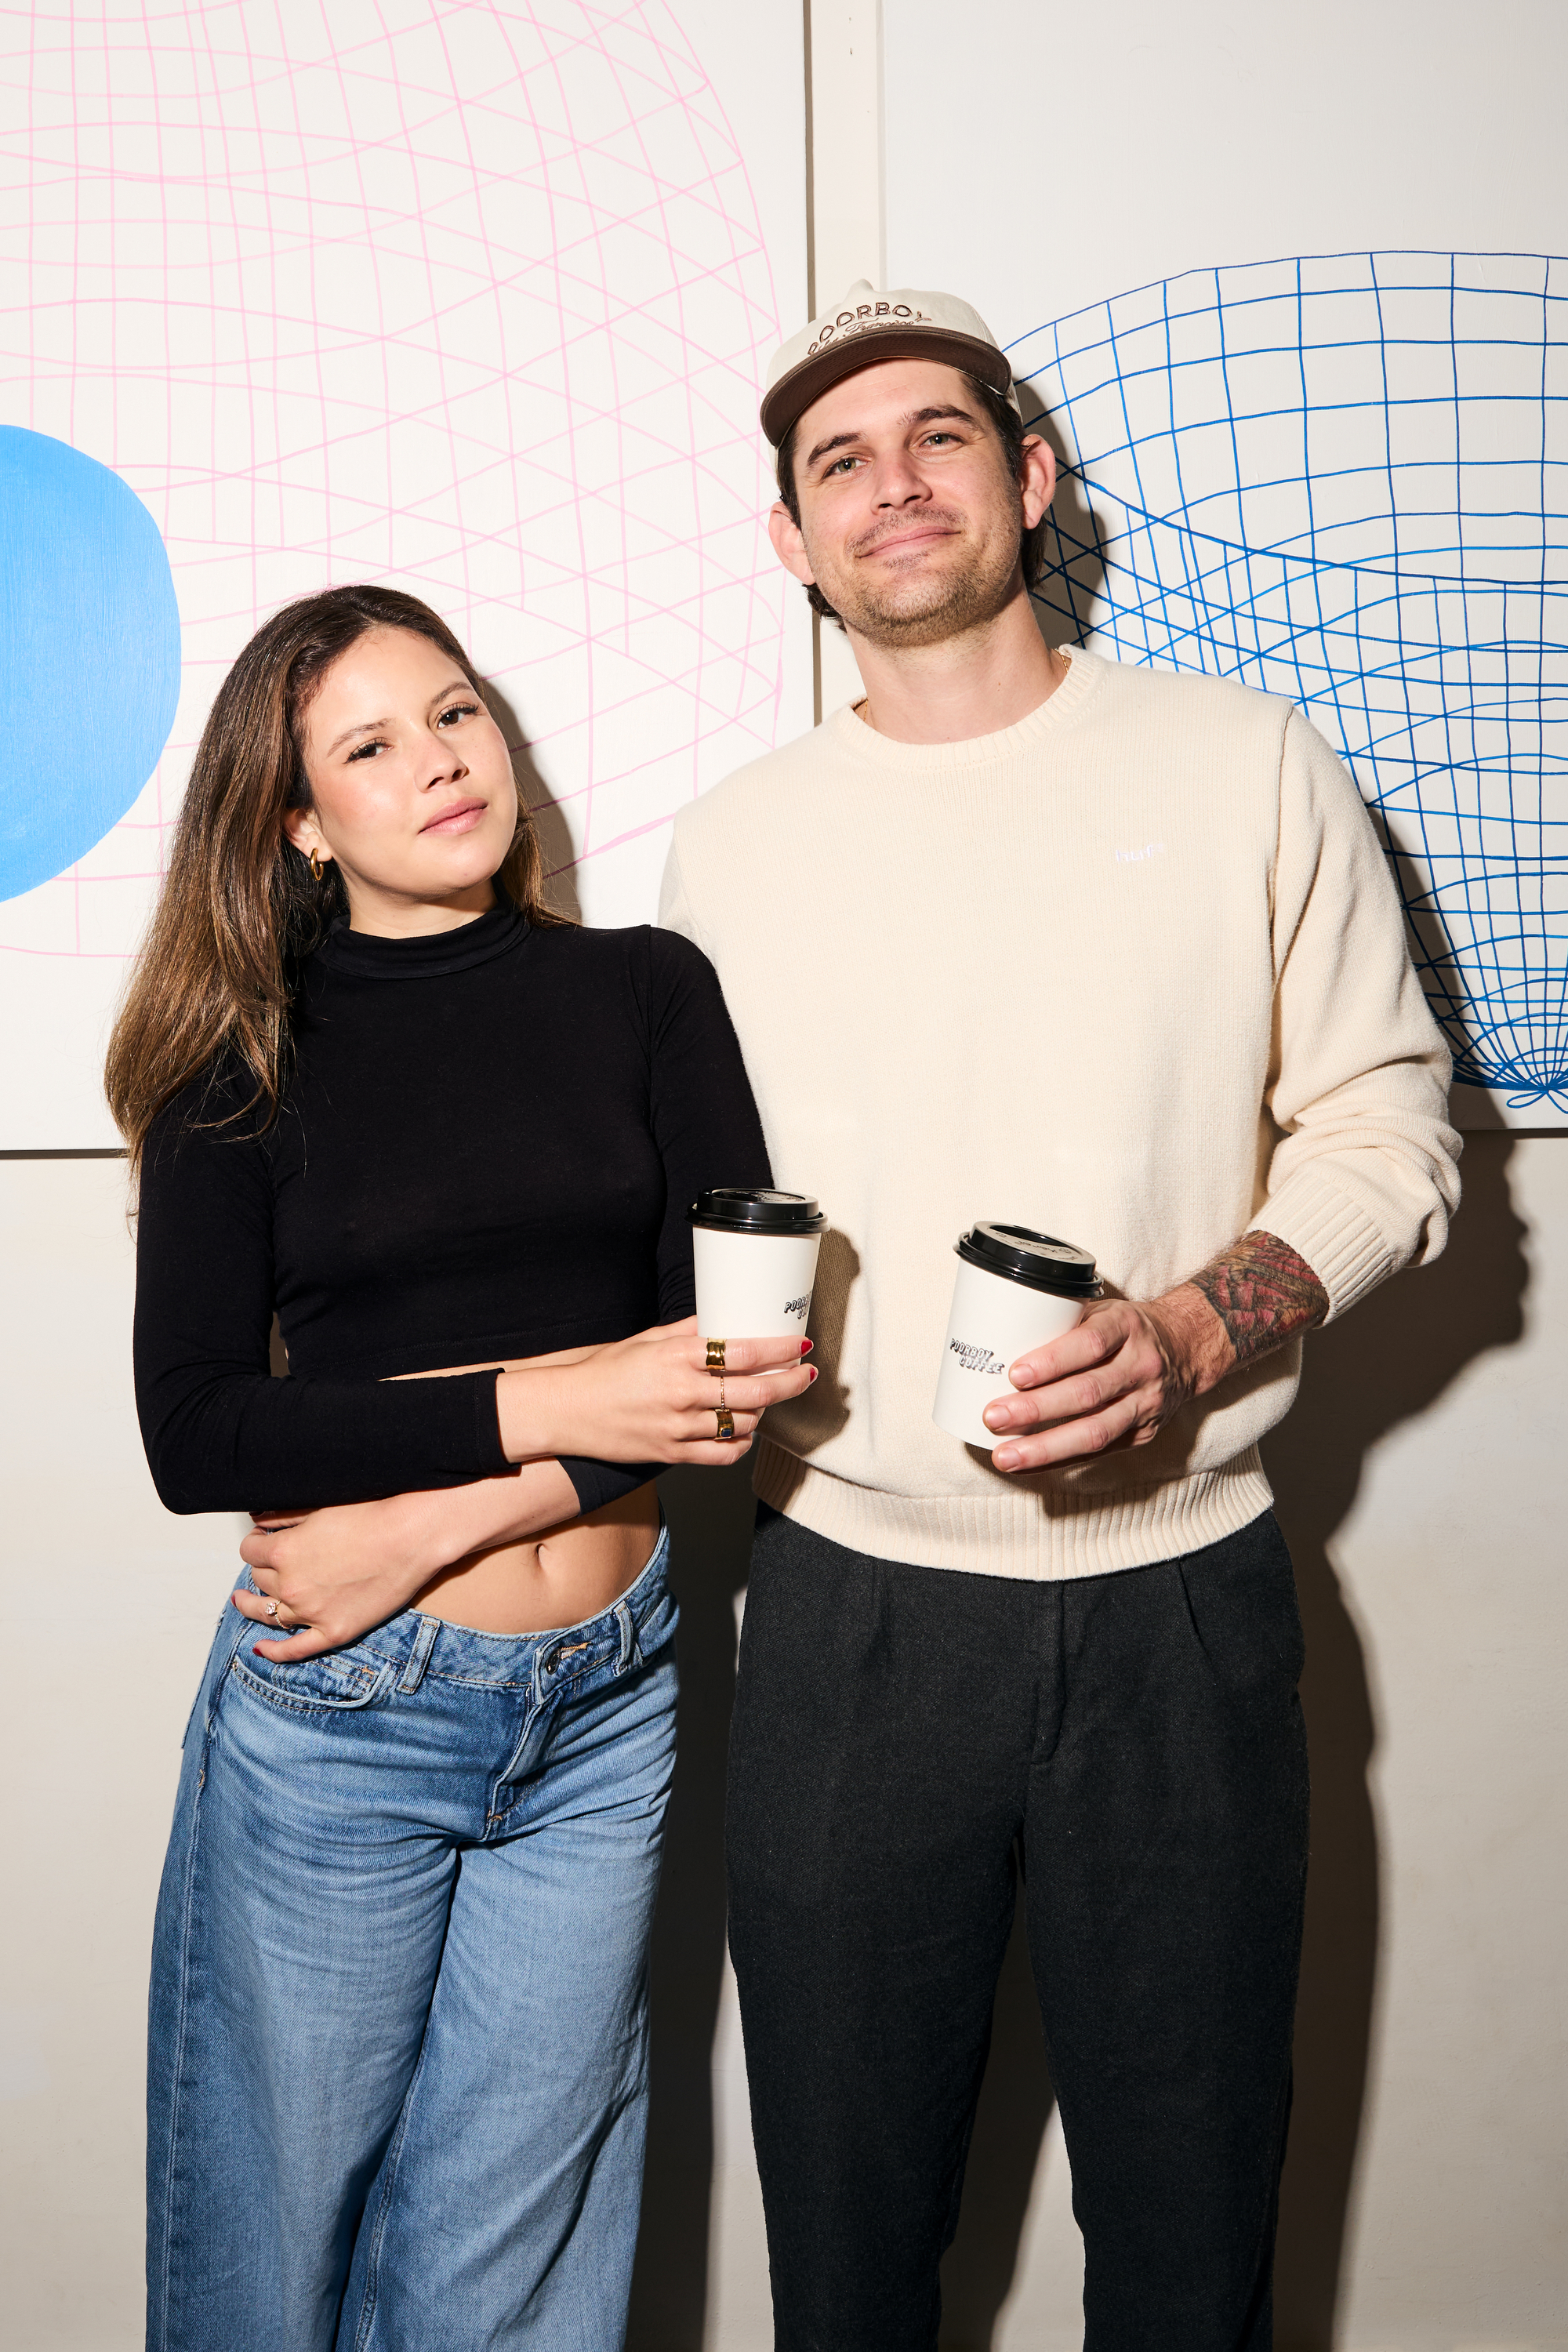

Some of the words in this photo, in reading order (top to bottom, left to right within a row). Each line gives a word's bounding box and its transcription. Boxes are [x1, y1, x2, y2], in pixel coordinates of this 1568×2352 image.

[808, 302, 931, 354] POORBOY
[949, 1338, 994, 1362] POORBOY
[959, 1355, 1006, 1374] COFFEE
